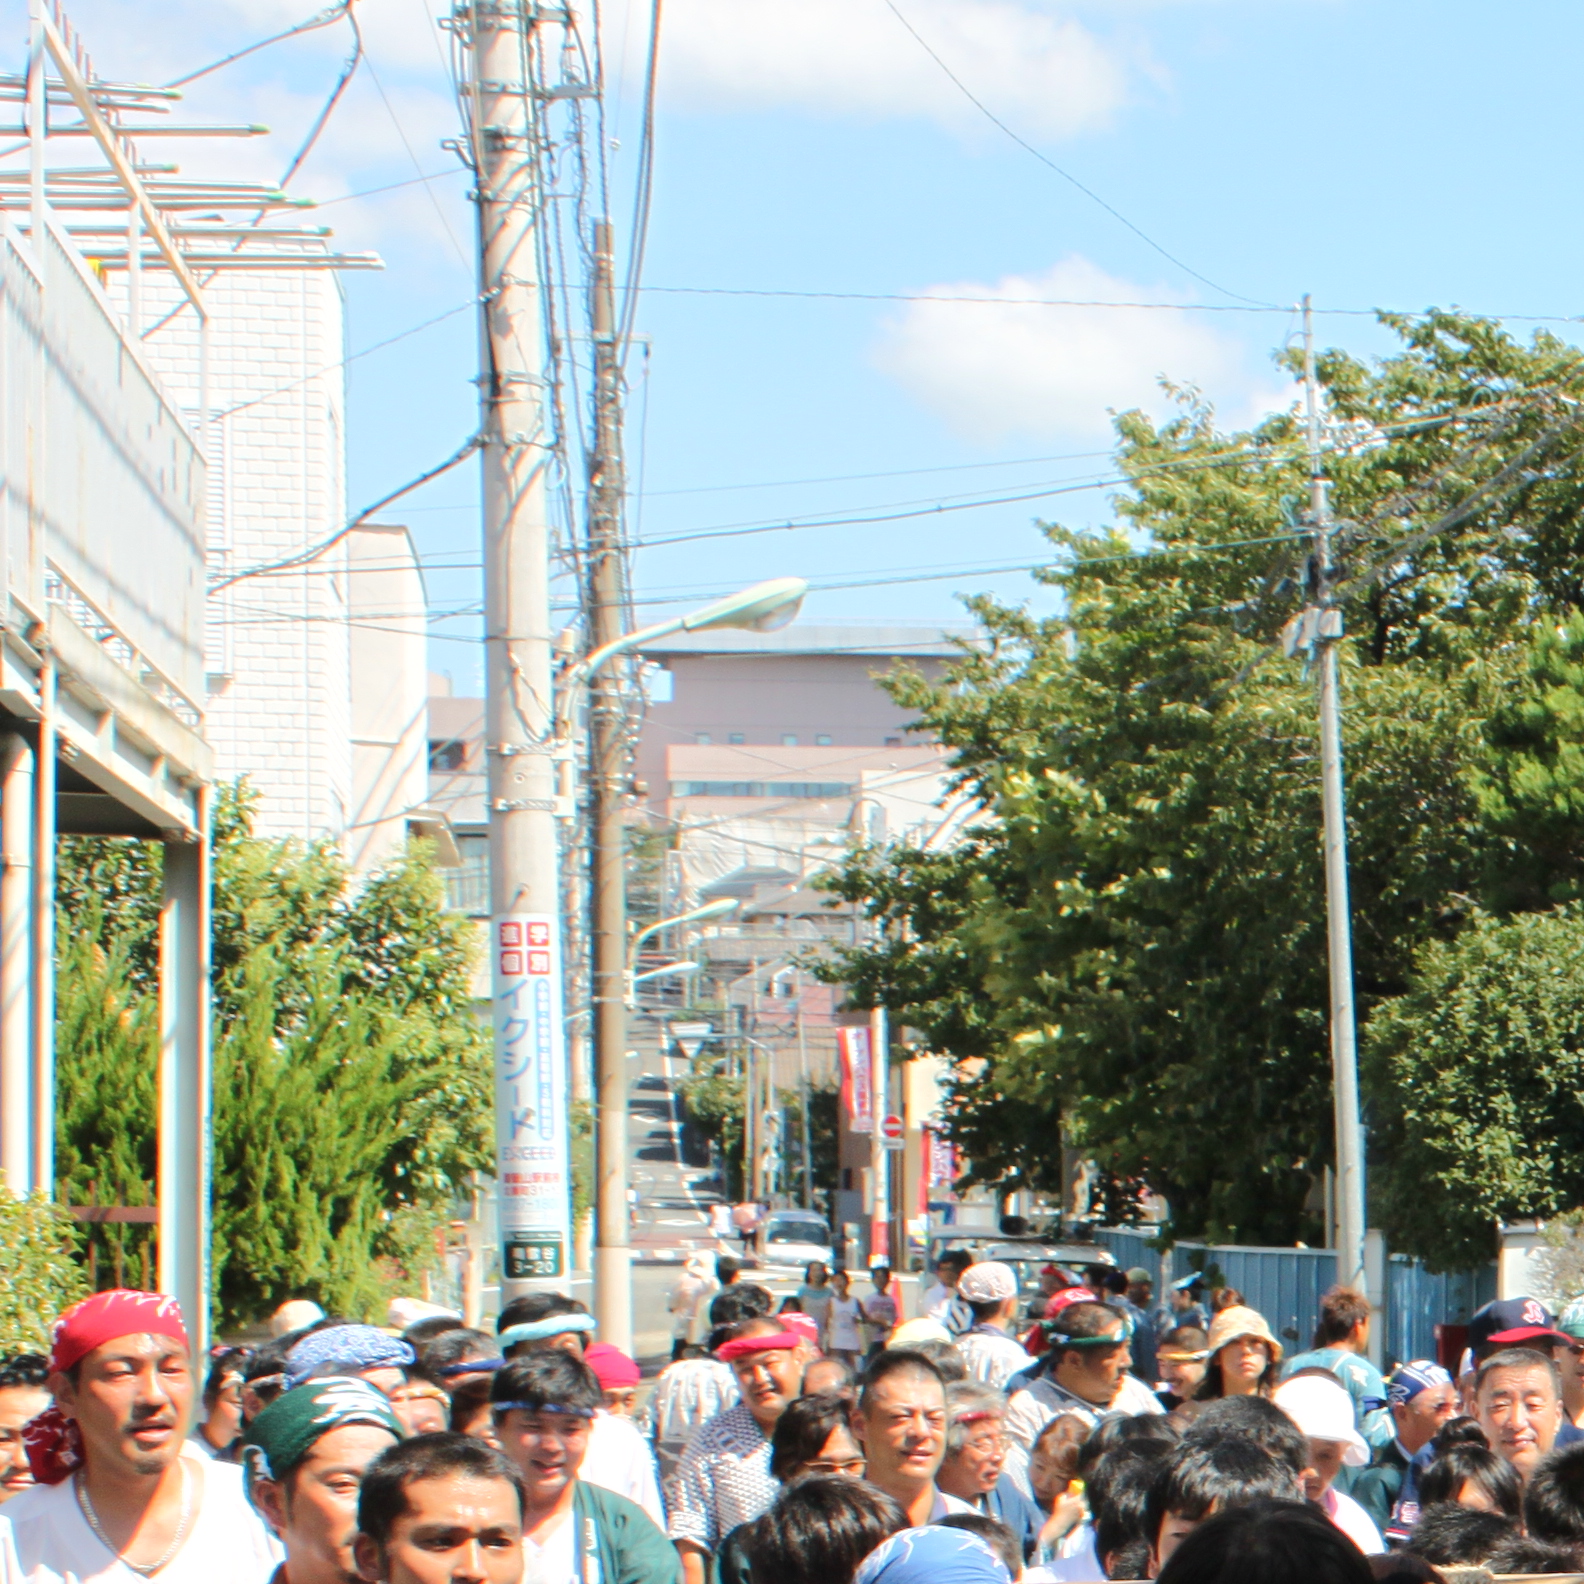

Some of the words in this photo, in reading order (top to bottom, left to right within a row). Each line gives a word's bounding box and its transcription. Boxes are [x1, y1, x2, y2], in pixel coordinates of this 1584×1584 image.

[499, 979, 536, 1140] イクシード
